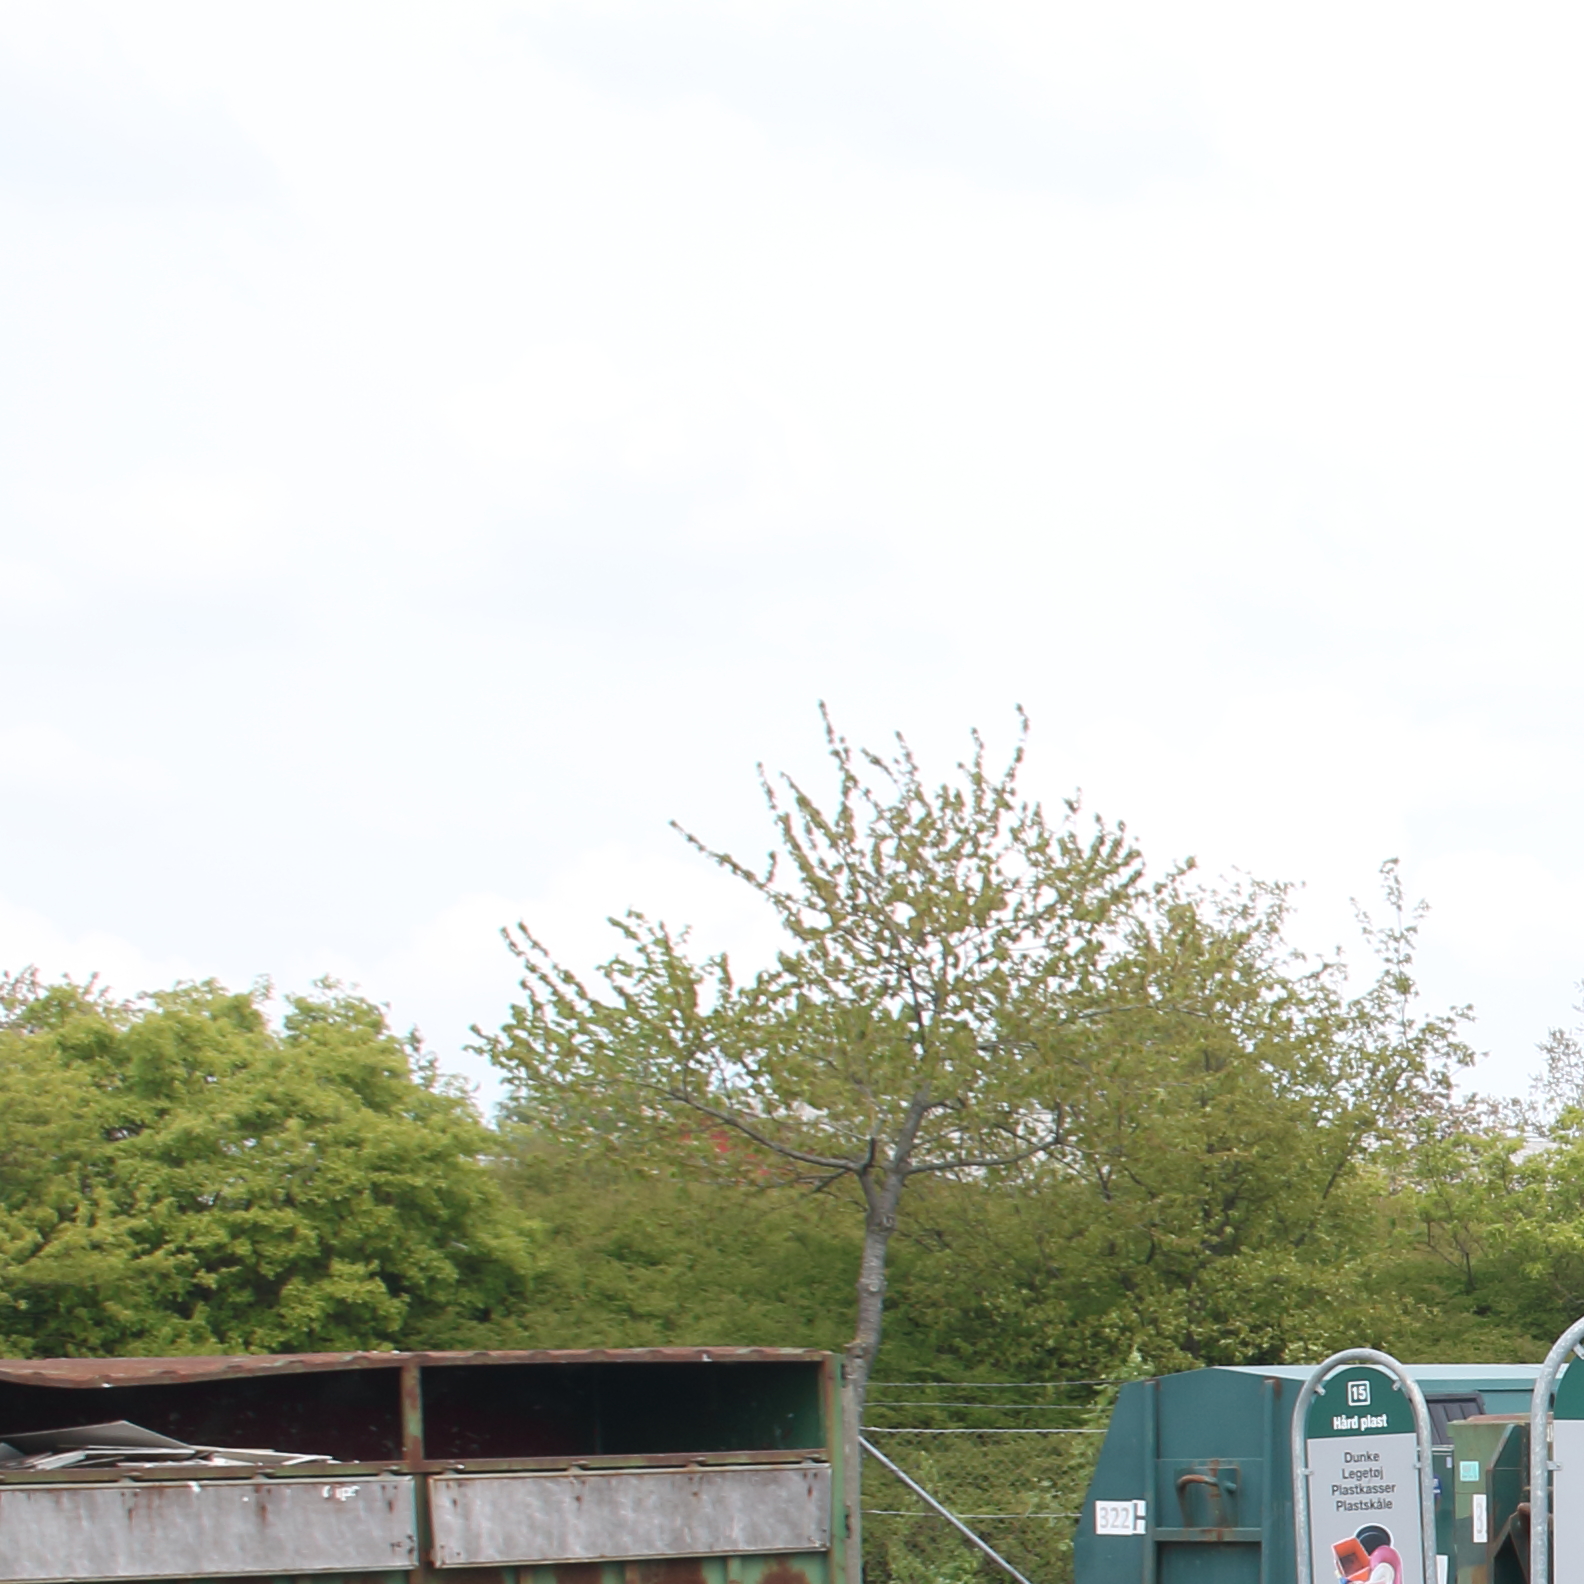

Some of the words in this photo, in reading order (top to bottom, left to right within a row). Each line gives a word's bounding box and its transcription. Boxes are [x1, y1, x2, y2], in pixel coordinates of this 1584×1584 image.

[1352, 1386, 1366, 1400] 15
[1333, 1415, 1358, 1430] Hård
[1361, 1413, 1388, 1431] plast
[1343, 1450, 1381, 1464] Dunke
[1341, 1467, 1385, 1482] Legetøj
[1331, 1482, 1397, 1497] Plastkasser
[1335, 1497, 1394, 1512] Plastskåle
